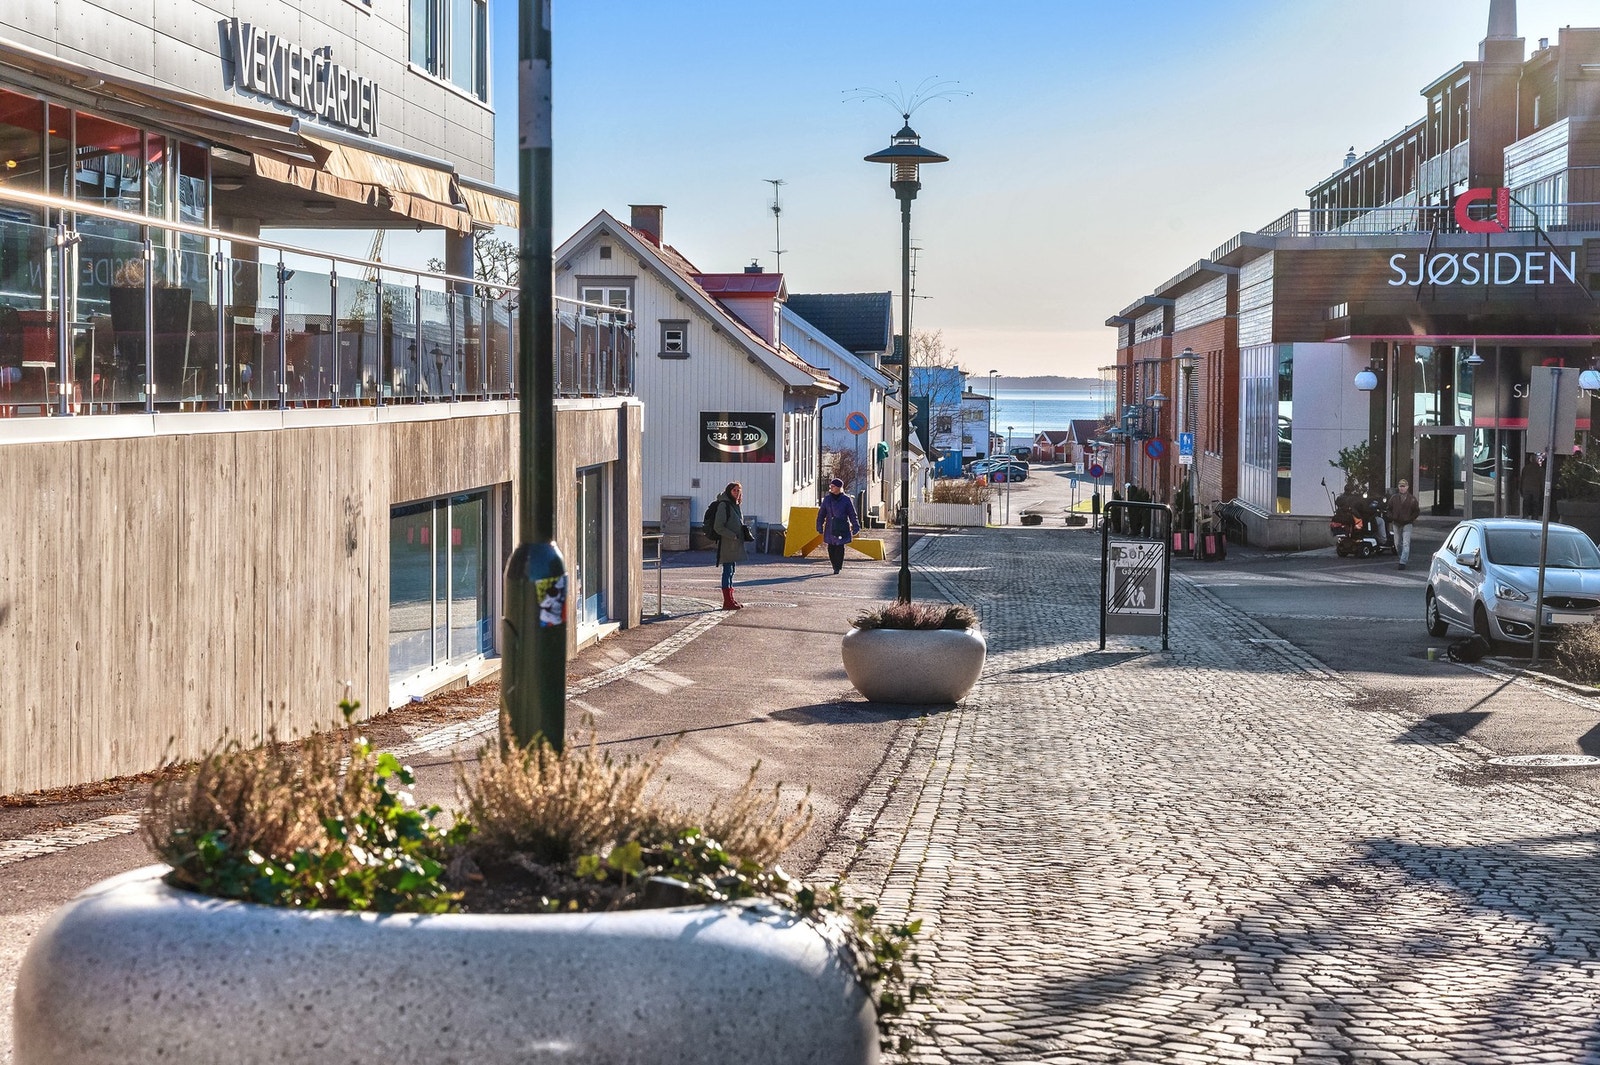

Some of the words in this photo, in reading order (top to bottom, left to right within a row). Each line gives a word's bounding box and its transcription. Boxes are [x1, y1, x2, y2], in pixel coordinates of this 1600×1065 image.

[233, 17, 379, 138] VEKTERGÅRDEN
[1499, 188, 1507, 221] CITYCON
[1387, 251, 1576, 286] SJØSIDEN
[712, 432, 728, 441] 334
[730, 432, 741, 441] 20
[743, 432, 760, 441] 200
